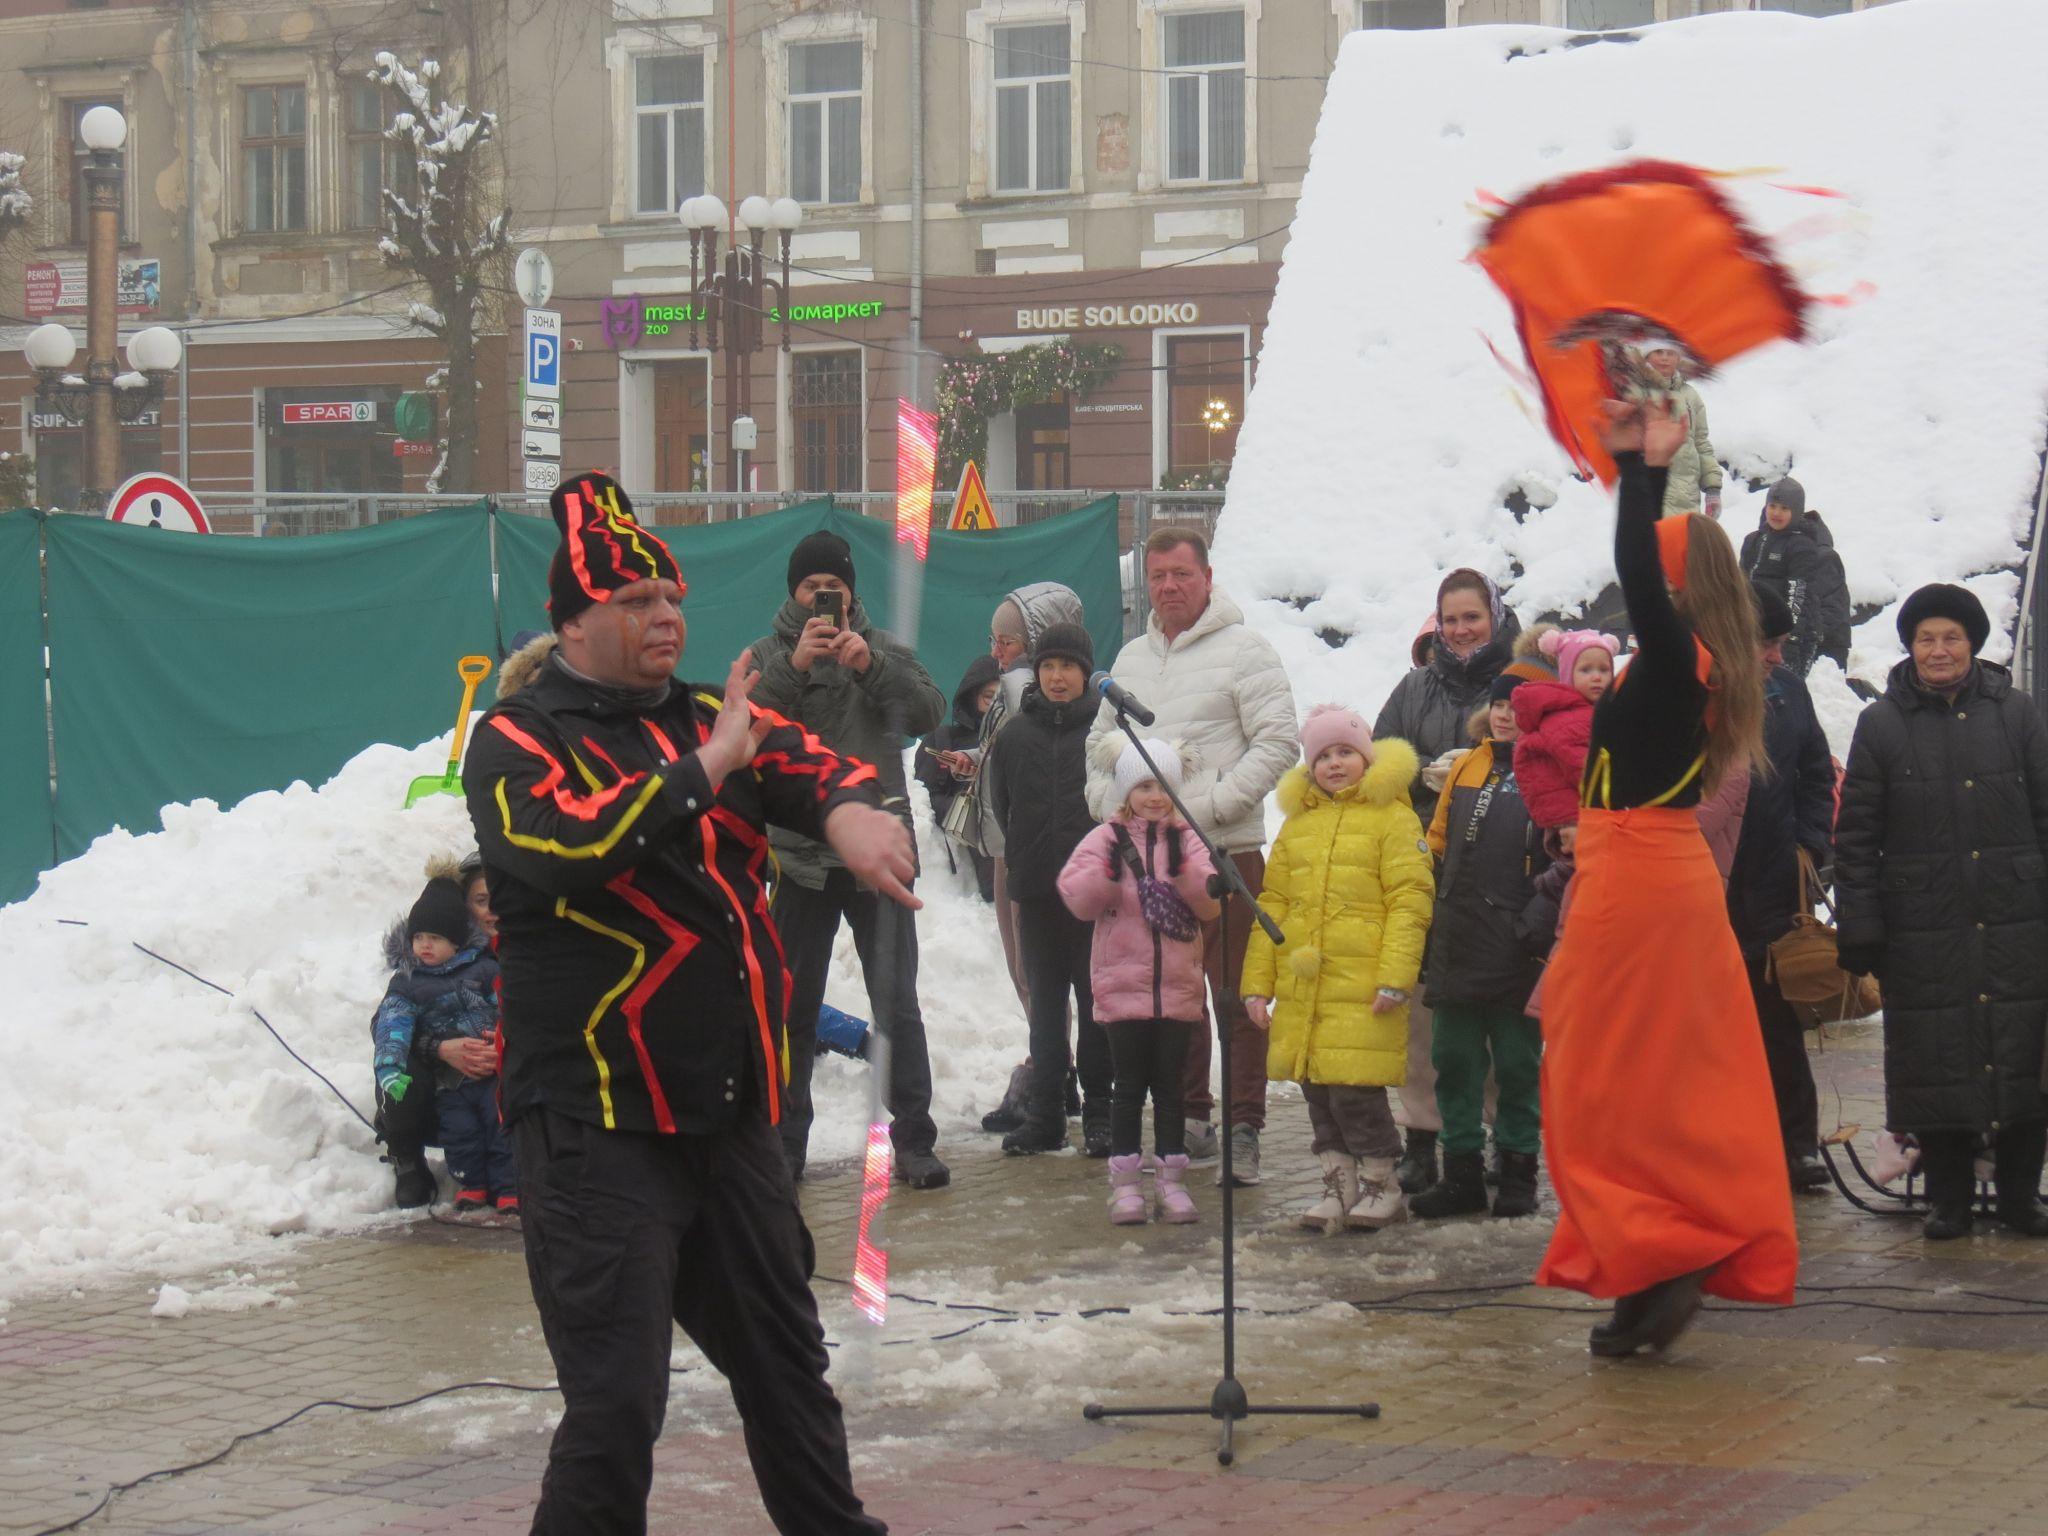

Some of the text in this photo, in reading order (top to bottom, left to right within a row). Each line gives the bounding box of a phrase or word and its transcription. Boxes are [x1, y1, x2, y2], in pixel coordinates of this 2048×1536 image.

[27, 269, 57, 281] РЕМОНТ
[769, 301, 882, 324] зомаркет
[1017, 302, 1199, 329] BUDE SOLODKO
[532, 315, 555, 329] ЗОНА
[645, 324, 669, 335] zoo
[534, 338, 554, 380] P
[299, 406, 351, 420] SPAR
[402, 444, 433, 455] SPAR
[547, 470, 556, 482] 50
